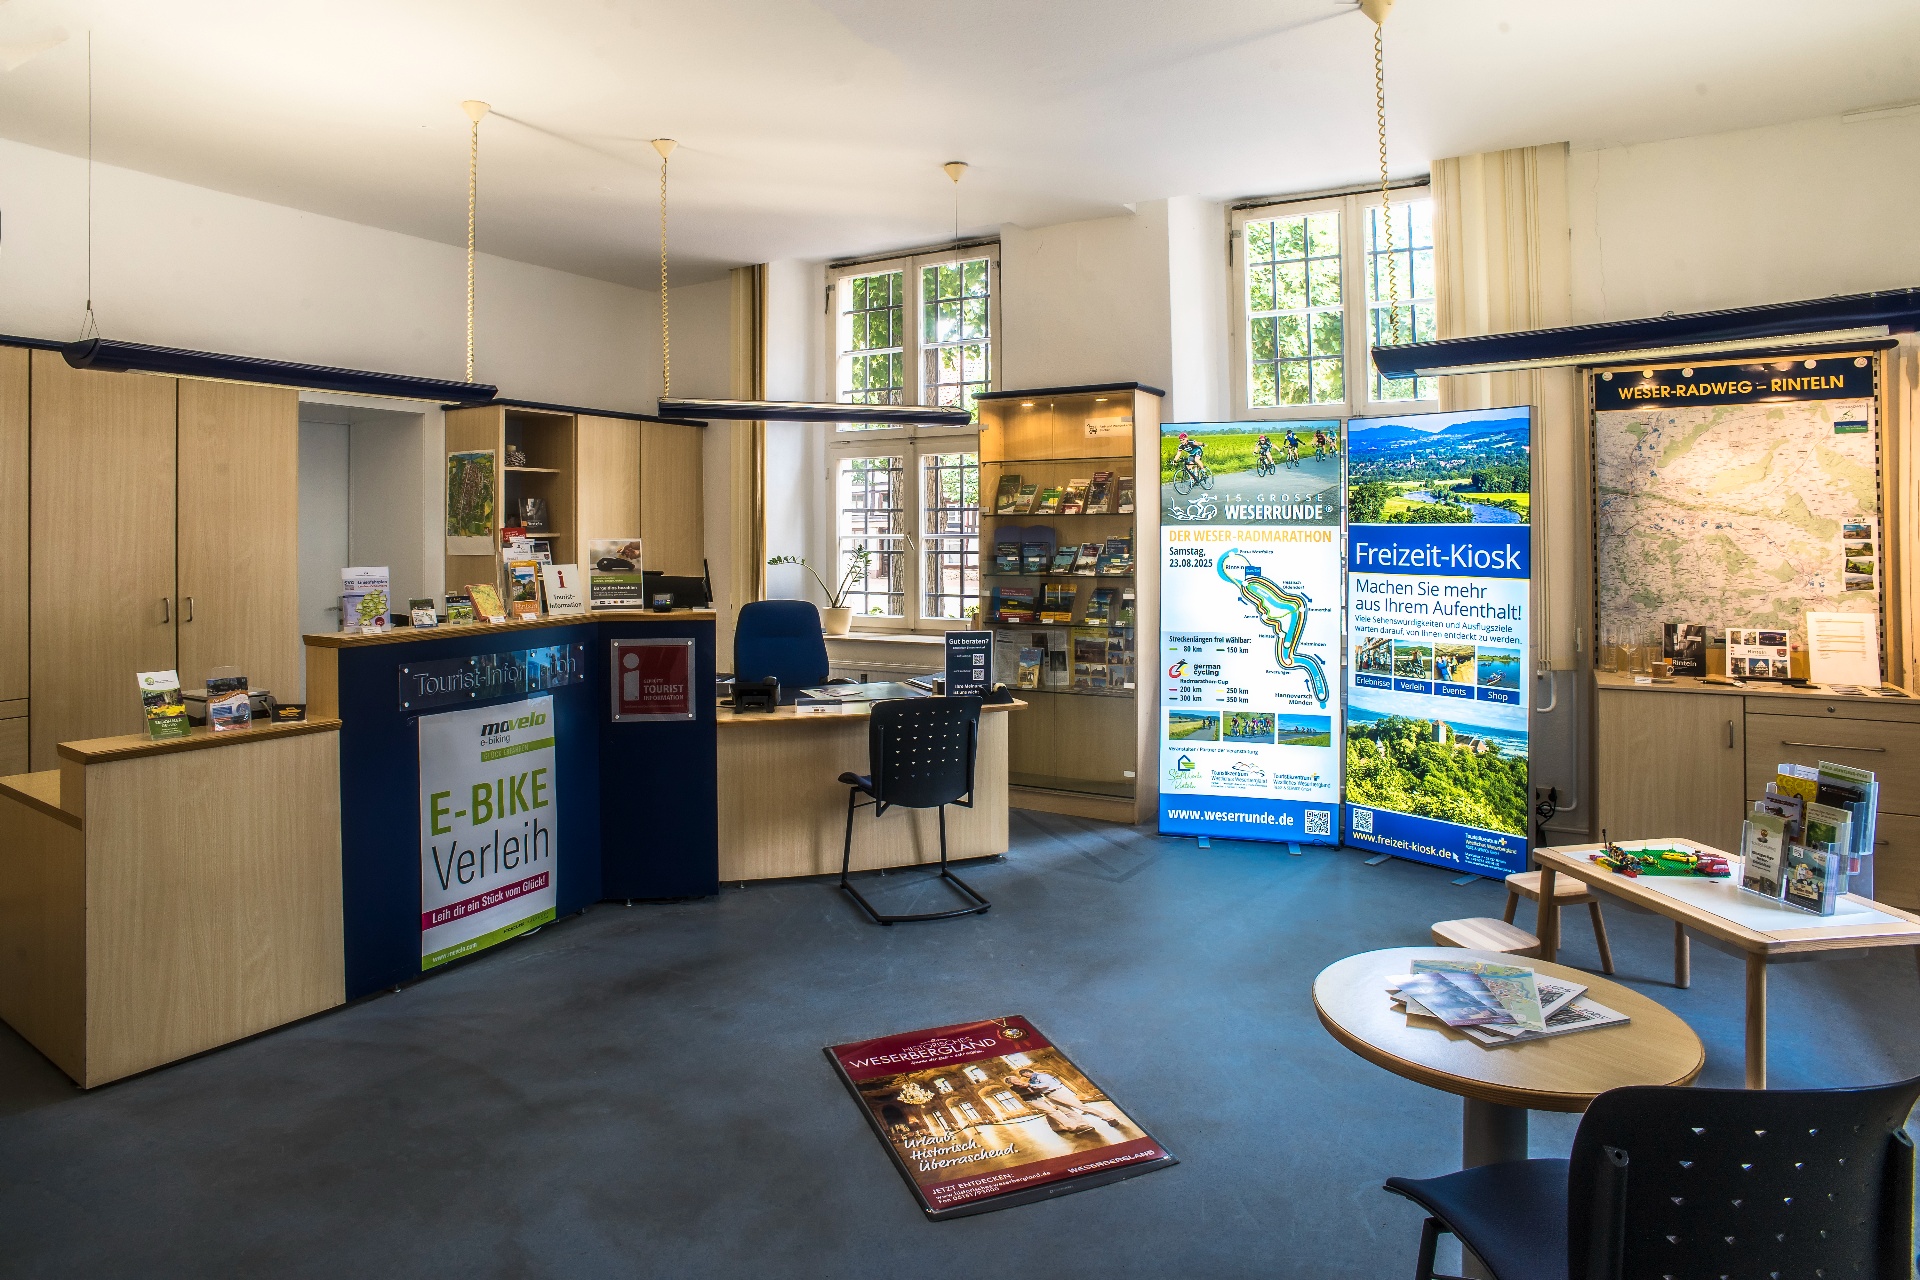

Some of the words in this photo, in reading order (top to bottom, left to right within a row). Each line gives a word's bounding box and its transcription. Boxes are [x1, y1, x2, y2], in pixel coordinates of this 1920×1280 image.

[1618, 380, 1752, 400] WESER-RADWEG
[1771, 375, 1844, 392] RINTELN
[1225, 493, 1249, 502] 15.
[1256, 493, 1324, 503] GROSSE
[1169, 531, 1191, 542] DER
[1194, 530, 1332, 543] WESER-RADMARATHON
[1169, 546, 1206, 558] Samstag,
[1356, 542, 1522, 570] Freizeit-Kiosk
[1169, 559, 1213, 568] 23.08.2025
[1356, 578, 1414, 596] Machen
[1417, 581, 1440, 596] Sie
[1444, 583, 1487, 599] mehr
[1355, 599, 1381, 612] aus
[1385, 598, 1429, 615] Ihrem
[1433, 600, 1522, 621] Aufenthalt!
[1355, 614, 1371, 623] Viele
[1373, 616, 1444, 629] Sehenswürdigkeiten
[1446, 621, 1461, 629] und
[1462, 621, 1513, 634] Ausflugsziele
[1169, 635, 1213, 645] Streckenlängen
[1225, 636, 1252, 644] wählbar:
[1355, 625, 1379, 634] warten
[1380, 626, 1405, 636] darauf,
[1421, 629, 1443, 638] Ihnen
[1444, 631, 1477, 641] entdeckt
[1490, 635, 1523, 645] werden.
[1192, 645, 1203, 653] km
[1227, 646, 1238, 654] 150
[1193, 669, 1220, 677] cycling
[643, 684, 684, 694] TOURIST
[1356, 676, 1391, 688] Erlebnisse
[1400, 681, 1425, 692] Verleih
[1442, 685, 1467, 696] Events
[1487, 691, 1508, 702] Shop
[480, 711, 547, 737] movelo
[480, 734, 511, 747] e-biking
[430, 767, 549, 837] E-BIKE
[1168, 808, 1294, 826] www.weserrunde.de
[431, 817, 550, 891] Verleih
[1352, 831, 1452, 859] www.freizeit-kiosk.de
[431, 908, 451, 924] Leih
[453, 903, 466, 918] dir
[467, 899, 481, 913] ein
[481, 890, 504, 908] Stück
[505, 887, 522, 900] vom
[522, 874, 547, 893] Glück!
[849, 1038, 997, 1069] WESERBERGLAND
[902, 1036, 973, 1053] HISTORISCHES
[910, 1138, 982, 1160] Historisch.
[919, 1143, 1019, 1172] Überraschend.
[1068, 1149, 1155, 1174] WESERBERGLAND
[932, 1184, 956, 1195] JETZT
[958, 1173, 1014, 1190] ENTDECKEN:
